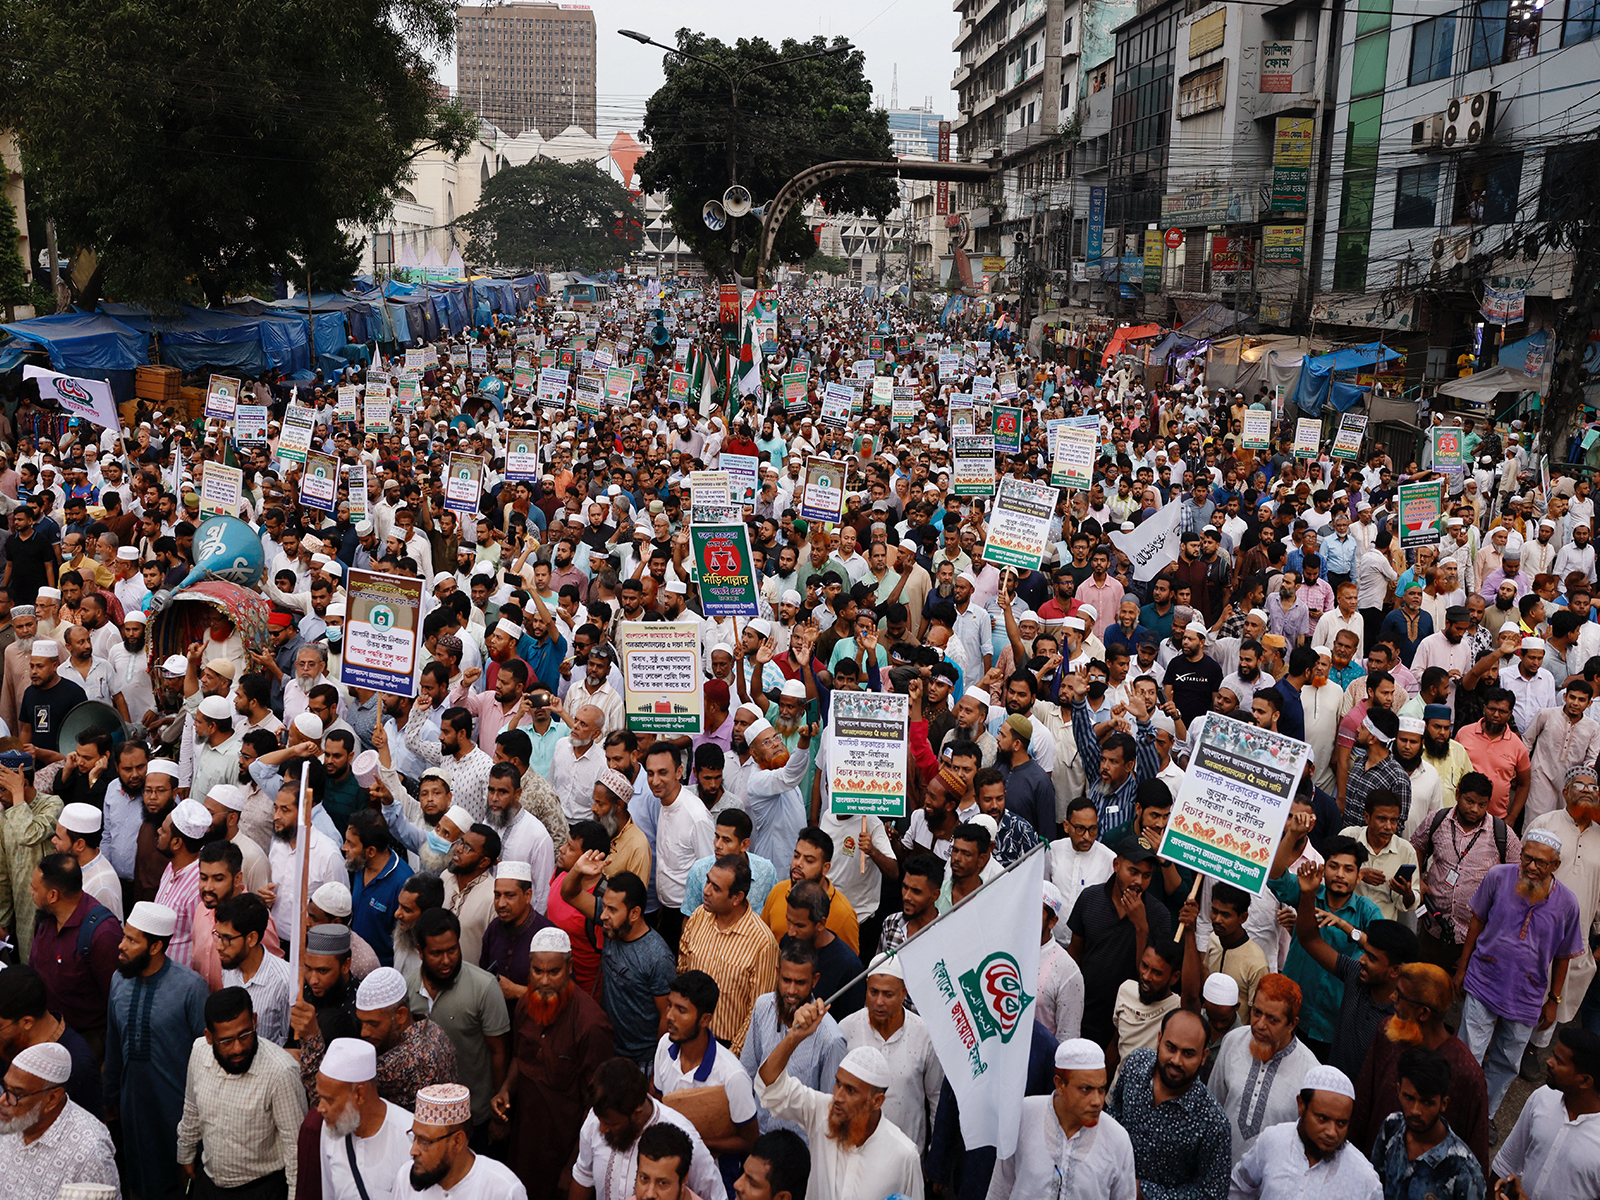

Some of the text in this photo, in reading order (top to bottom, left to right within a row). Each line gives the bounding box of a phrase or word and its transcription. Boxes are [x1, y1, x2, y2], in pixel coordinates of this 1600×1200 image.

[1265, 58, 1290, 68] ফোম
[1201, 747, 1291, 784] বাংলাদেশ জামায়াতে ইসলামীর
[1246, 772, 1256, 782] ৫
[1255, 777, 1268, 787] দফা
[1268, 781, 1282, 792] দাবি
[1194, 767, 1281, 808] ফ্যাসিস্ট সরকারের সকল
[1204, 785, 1261, 816] জুলুম-নির্যাতন
[1181, 800, 1271, 846] বিচার দৃশ্যমান করতে হবে
[1195, 796, 1265, 831] গণহত্যা ও দুর্নীতির
[1169, 836, 1260, 878] বাংলাদেশ জামায়াতে ইসলামী
[1181, 851, 1241, 880] ঢাকা মহানগরী দক্ষিণ
[932, 958, 988, 1080] বাংলাদেশ জামায়াতে ইসলামী
